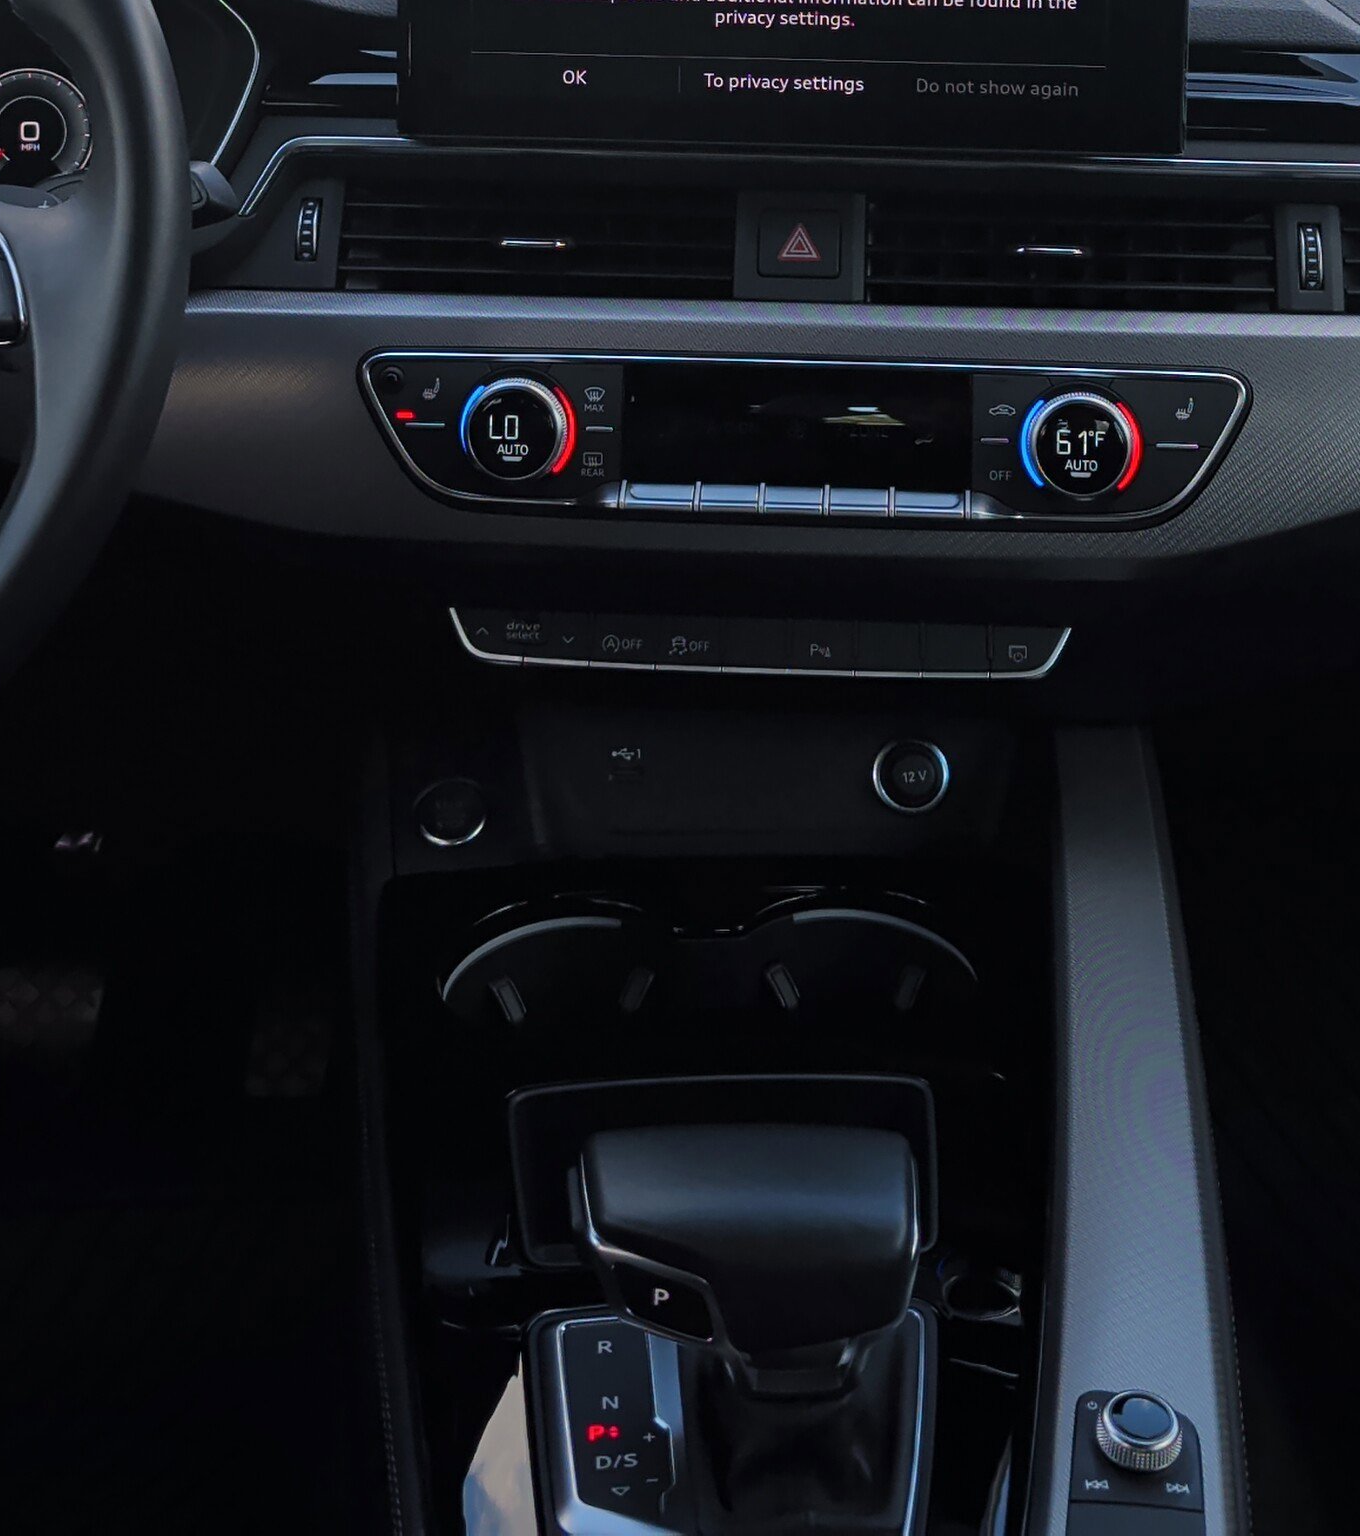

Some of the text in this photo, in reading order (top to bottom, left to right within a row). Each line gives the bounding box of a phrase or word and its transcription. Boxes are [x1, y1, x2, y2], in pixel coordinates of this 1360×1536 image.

[715, 10, 856, 31] privacy settings.
[562, 70, 587, 85] OK
[704, 72, 865, 95] To privacy settings
[916, 78, 1079, 99] Do not show again
[19, 120, 40, 142] 0
[20, 143, 41, 152] MPH
[583, 403, 605, 413] MAX
[489, 414, 519, 440] LO
[496, 443, 529, 456] AUTO
[1064, 459, 1099, 472] AUTO
[580, 468, 605, 477] REAR
[989, 470, 1013, 481] OFF
[506, 621, 540, 631] drive
[506, 630, 540, 640] select
[621, 640, 643, 650] OFF
[689, 641, 711, 652] OFF
[903, 770, 927, 783] 12 V
[653, 1288, 670, 1306] P
[597, 1340, 613, 1354] R
[602, 1395, 619, 1410] N
[595, 1453, 638, 1470] D/S
